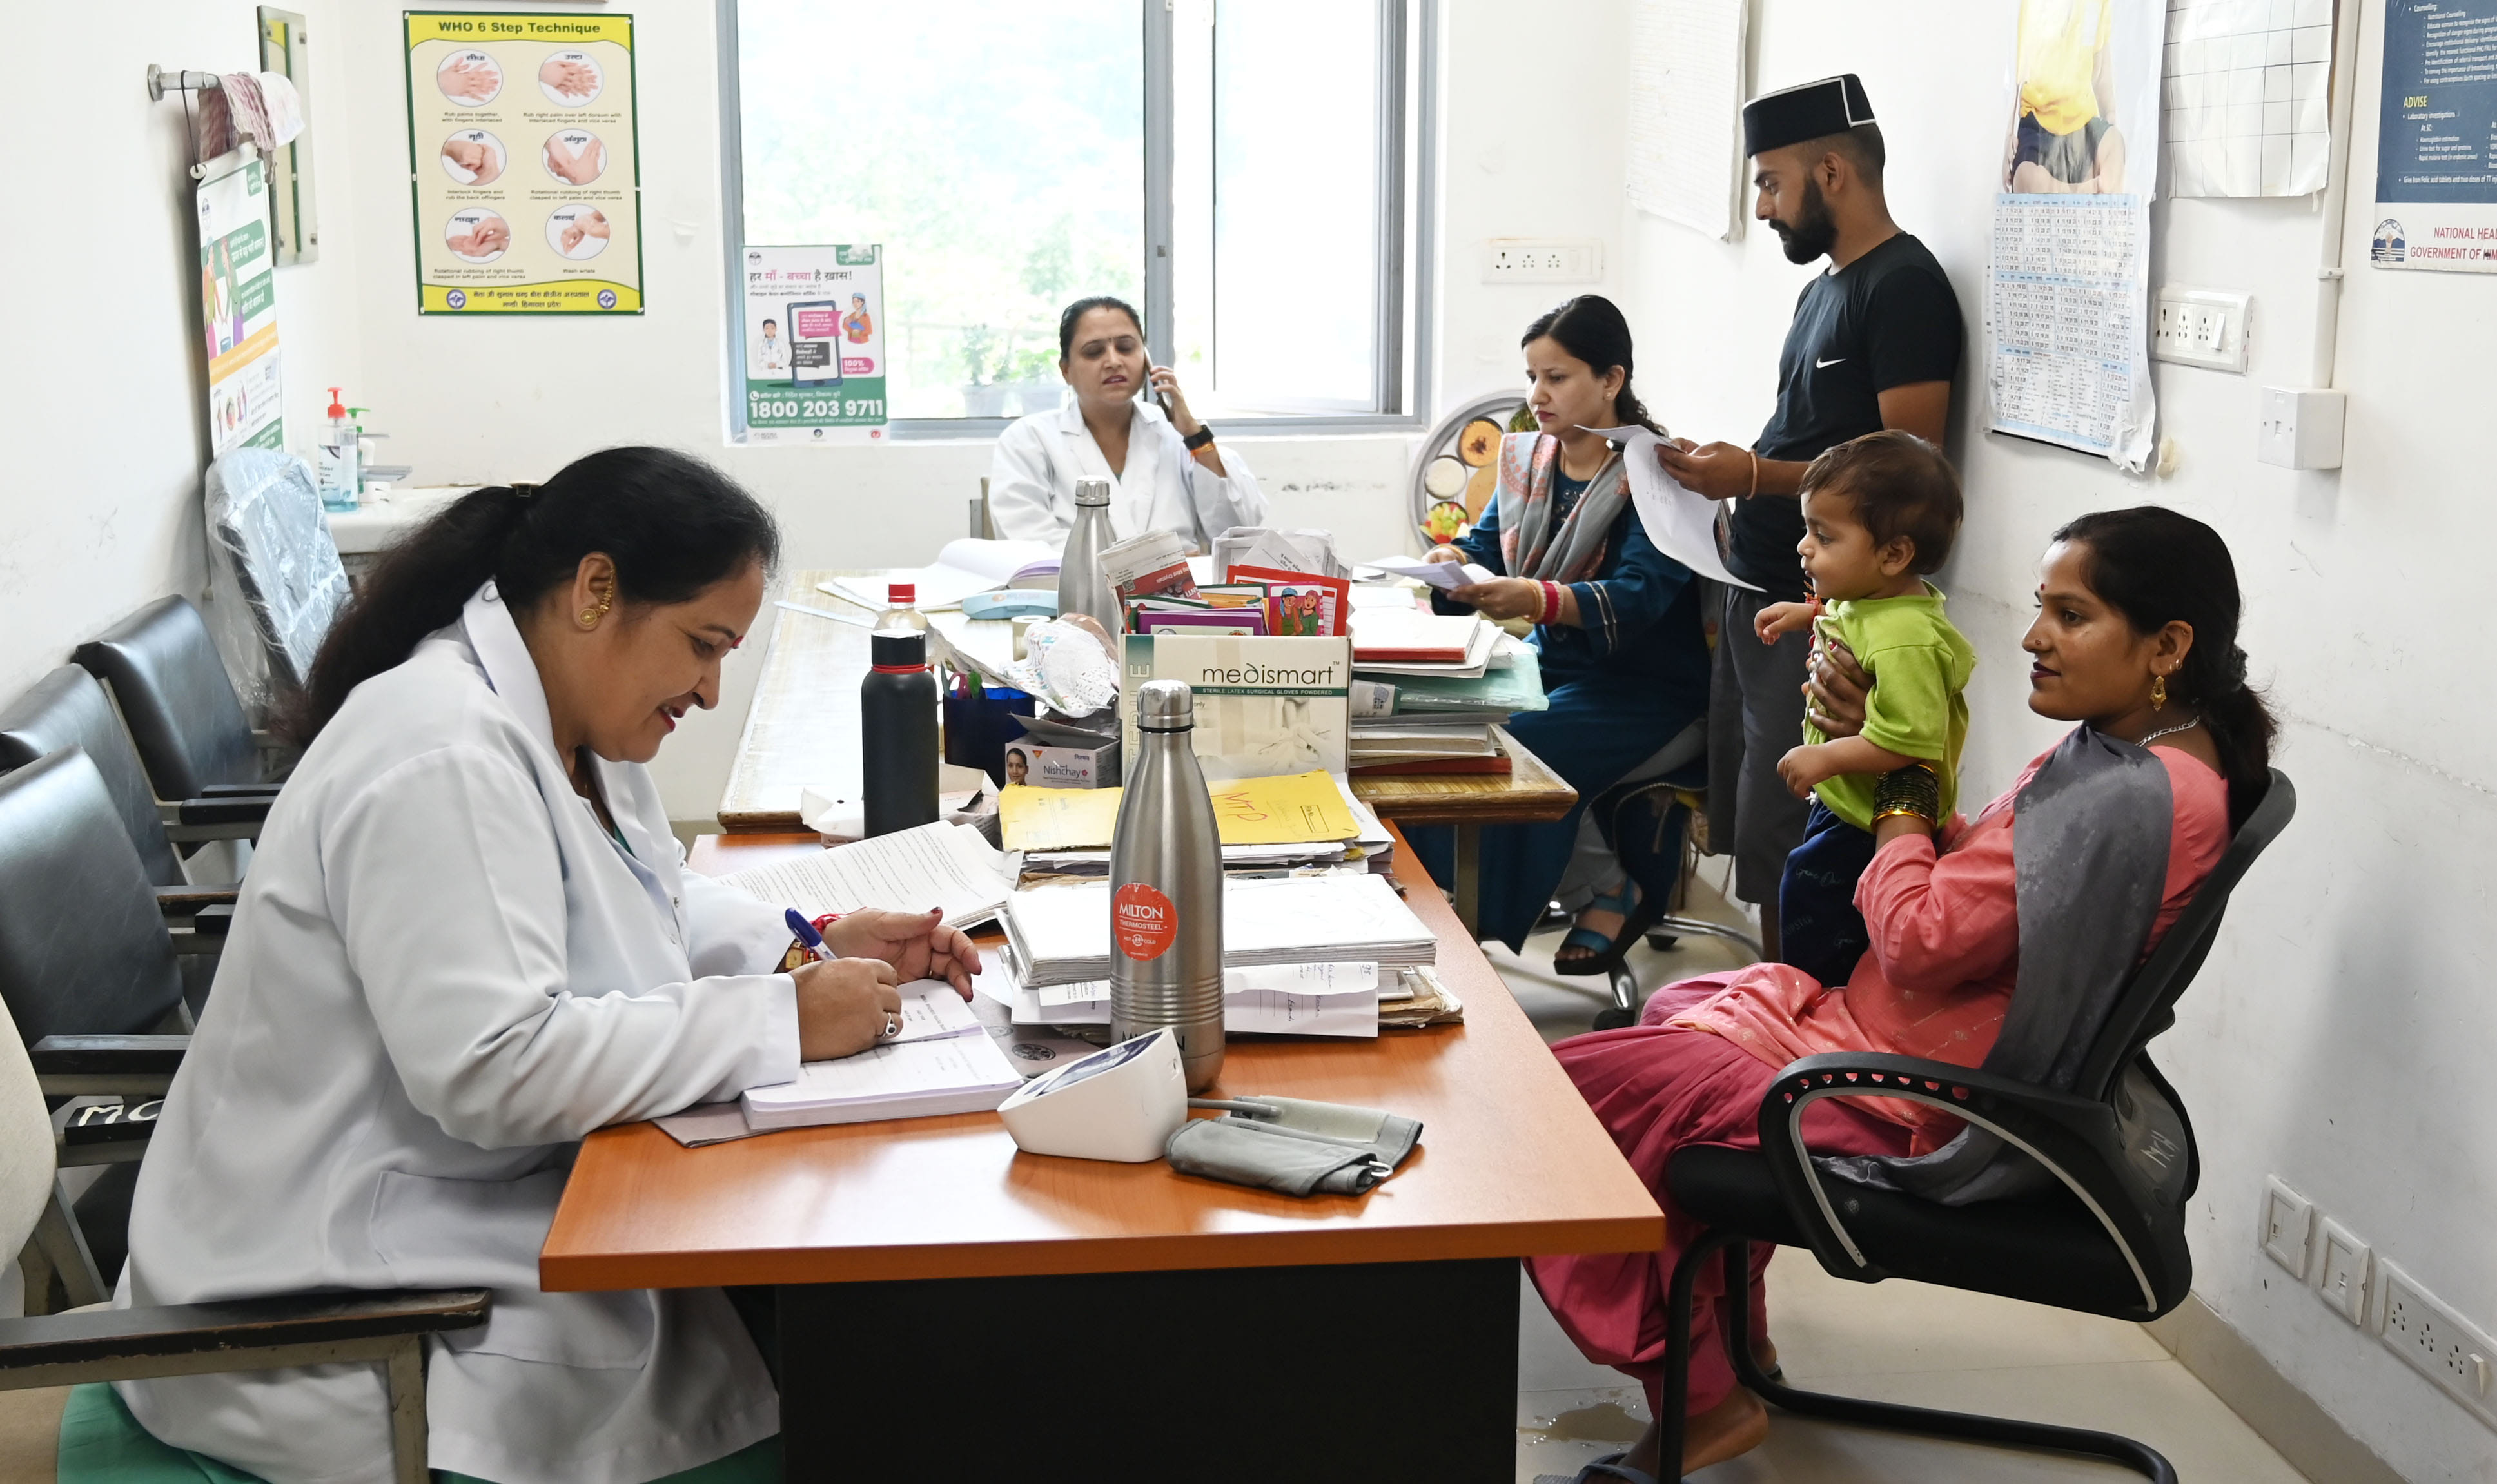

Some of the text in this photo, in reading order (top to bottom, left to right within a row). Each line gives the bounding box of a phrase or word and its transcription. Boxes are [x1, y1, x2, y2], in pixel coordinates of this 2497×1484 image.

[439, 22, 600, 35] WHO 6 Step Technique
[2404, 96, 2427, 108] ADVISE
[2434, 227, 2474, 239] NATIONAL
[2410, 247, 2467, 259] GOVERNMENT
[2469, 248, 2481, 259] OF
[750, 273, 761, 282] हर
[765, 269, 777, 280] माँ
[787, 272, 811, 281] बच्चा
[814, 269, 821, 281] है
[750, 400, 883, 418] 1800 203 9711
[1202, 663, 1334, 685] medismart
[1043, 765, 1081, 778] Nishchay
[1119, 903, 1163, 919] MILTON
[1119, 919, 1162, 930] THERMOSTEEL
